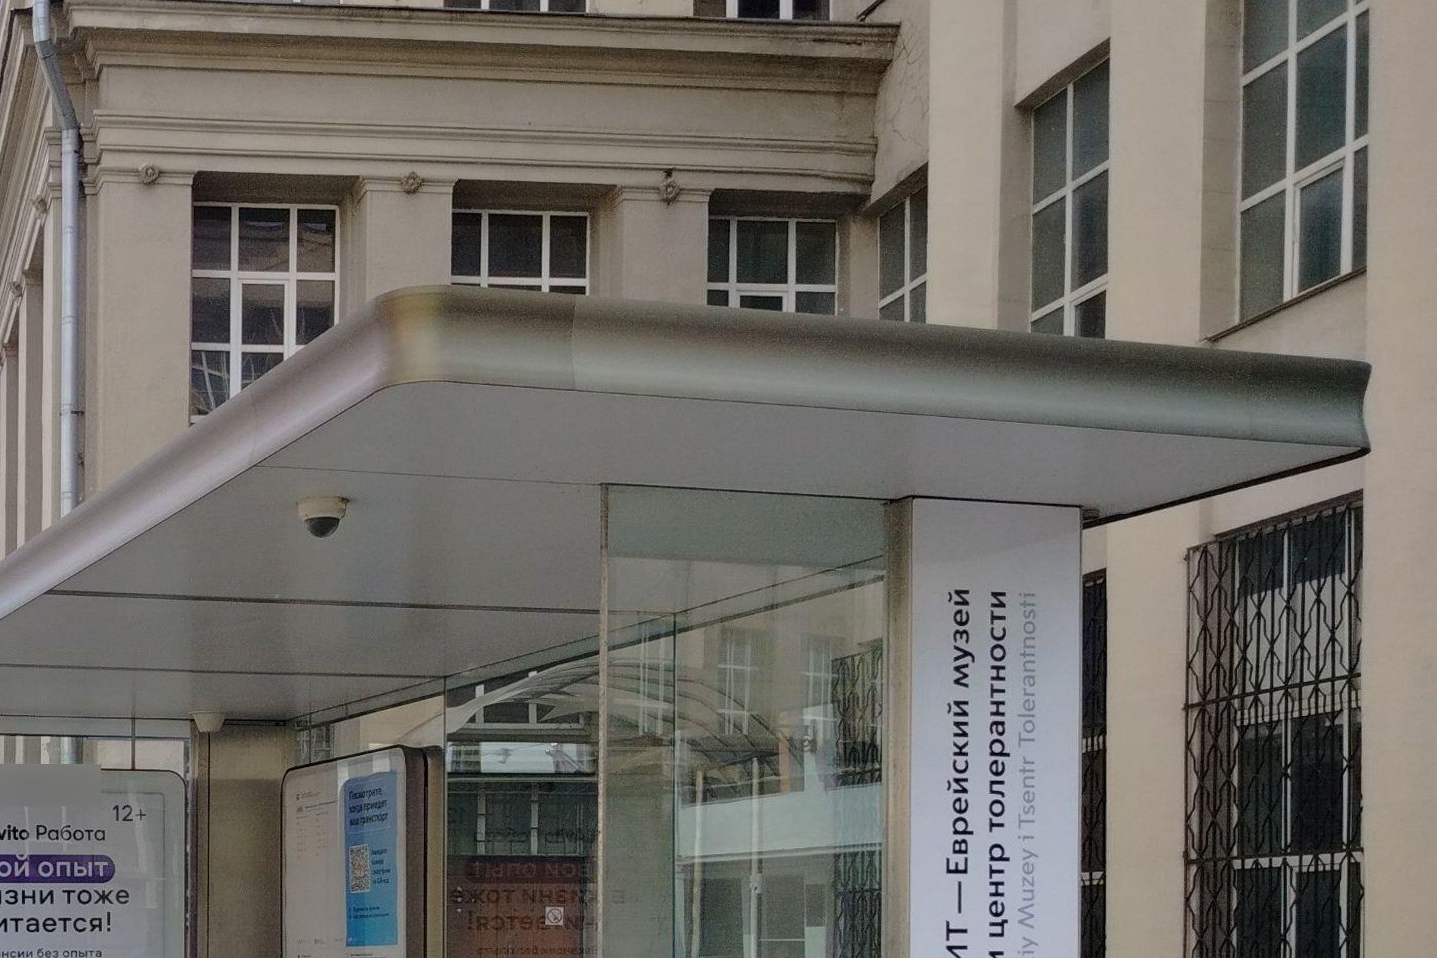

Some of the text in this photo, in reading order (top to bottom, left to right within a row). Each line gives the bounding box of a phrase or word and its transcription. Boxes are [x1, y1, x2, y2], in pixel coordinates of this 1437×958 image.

[947, 589, 975, 688] музей
[1016, 592, 1036, 748] Tolerantnosti
[988, 591, 1010, 833] толерантности
[112, 804, 147, 822] 12+
[946, 700, 974, 875] Еврейский
[1017, 756, 1036, 829] Tsentr
[36, 824, 106, 842] Работа
[37, 860, 109, 879] опыт
[62, 888, 130, 905] тоже
[988, 843, 1010, 938] центр
[1017, 848, 1038, 929] Muzey
[36, 948, 60, 958] без
